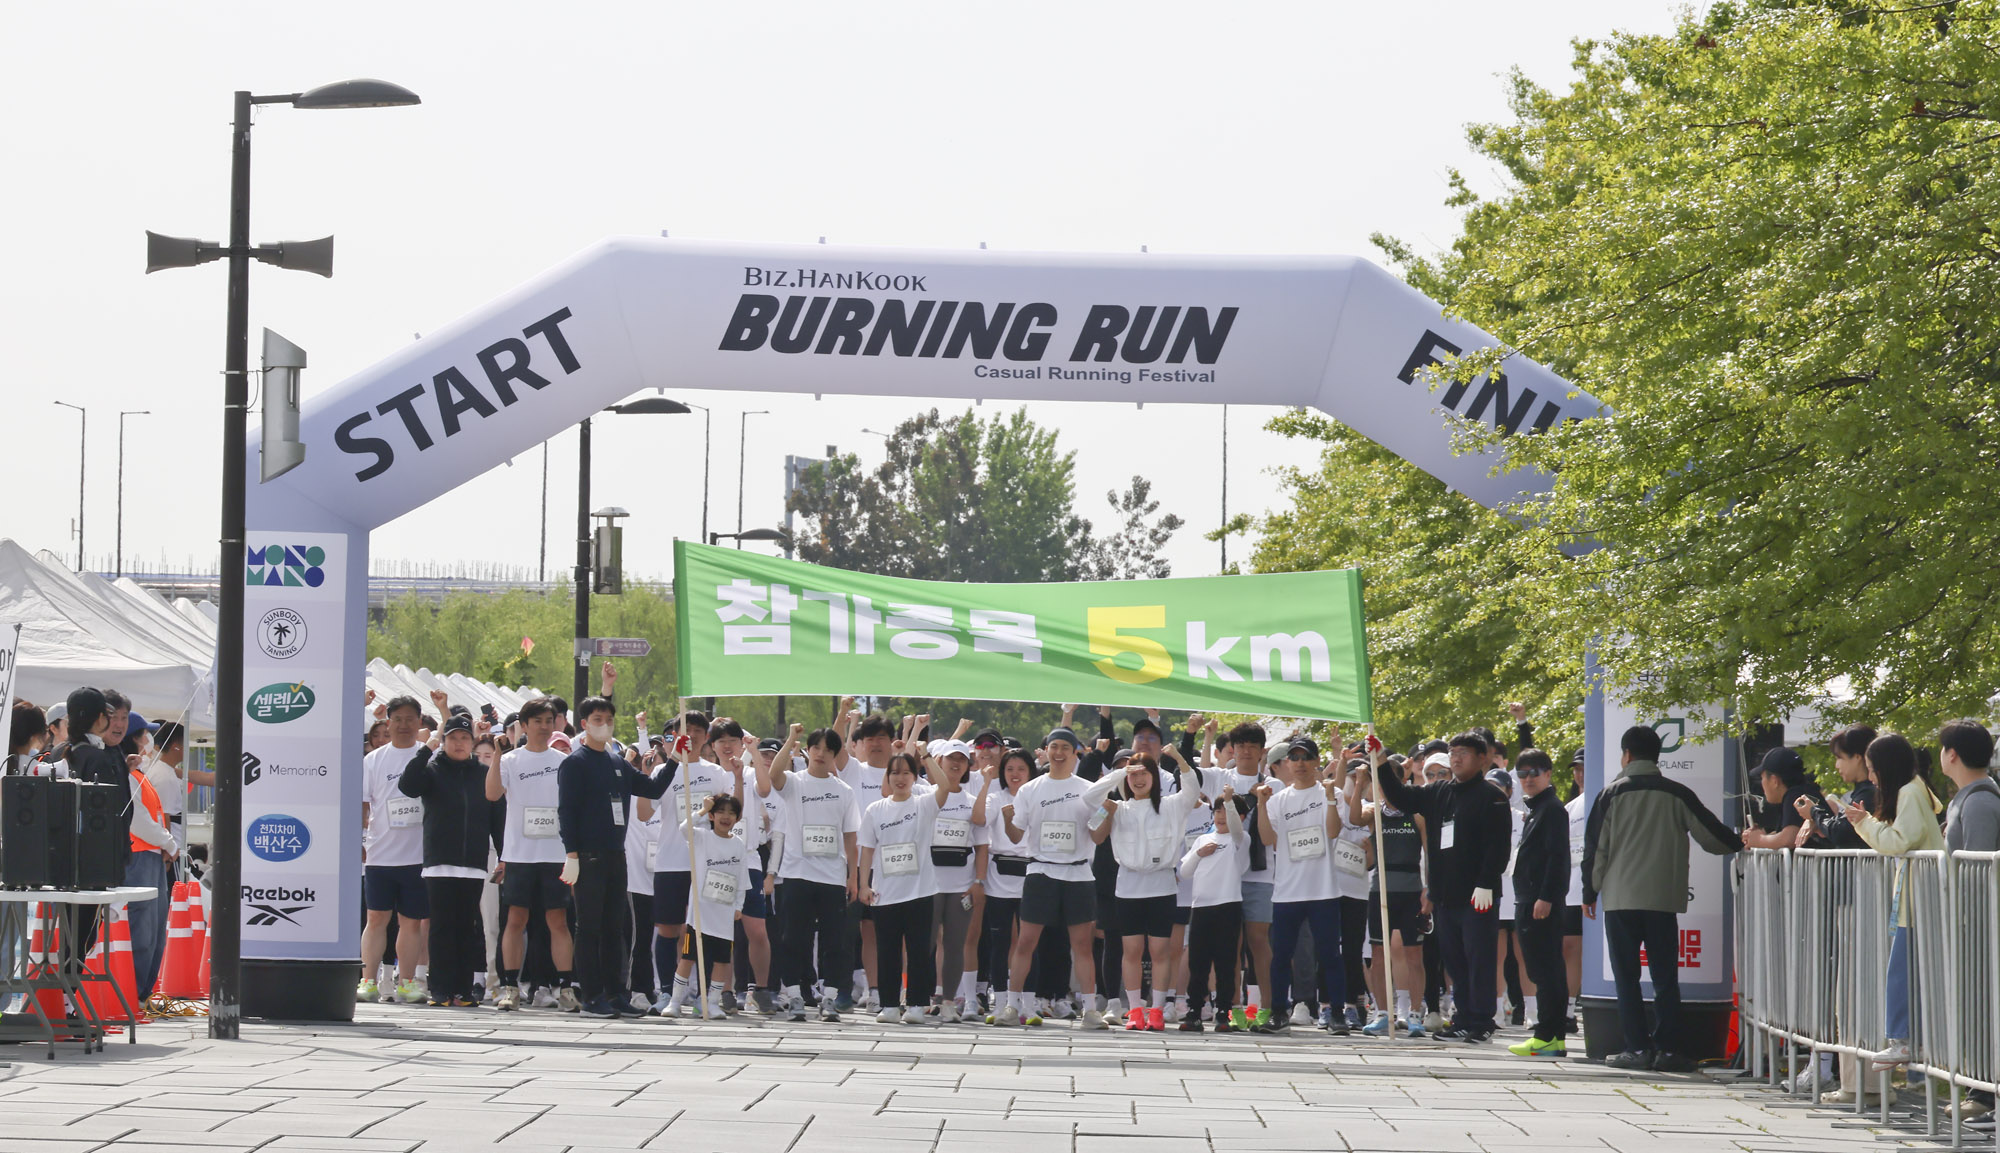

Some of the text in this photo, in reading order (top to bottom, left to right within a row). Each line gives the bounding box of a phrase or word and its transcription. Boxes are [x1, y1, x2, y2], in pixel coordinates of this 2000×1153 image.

[719, 294, 1240, 364] BURNING RUN
[974, 365, 1215, 384] Casual Running Festival
[1397, 328, 1583, 440] FINI
[334, 306, 582, 482] START
[247, 545, 326, 566] MONO
[246, 566, 325, 588] MANO
[263, 610, 302, 626] SUNBODY
[714, 579, 1043, 663] 참가종목
[266, 644, 298, 657] TANNING
[253, 692, 310, 717] 셀렉스
[269, 764, 328, 777] MemorinG
[1658, 760, 1695, 770] PLANET
[398, 806, 420, 816] 5242
[533, 817, 555, 825] 5204
[260, 824, 296, 835] 천지차이
[943, 829, 966, 838] 6353
[1049, 832, 1072, 840] 5070
[254, 836, 302, 854] 백산수
[812, 835, 835, 844] 5213
[1297, 836, 1320, 848] 5049
[890, 853, 914, 863] 6279
[1342, 851, 1364, 864] 6154
[713, 881, 735, 893] 5159
[241, 885, 316, 903] Reebok
